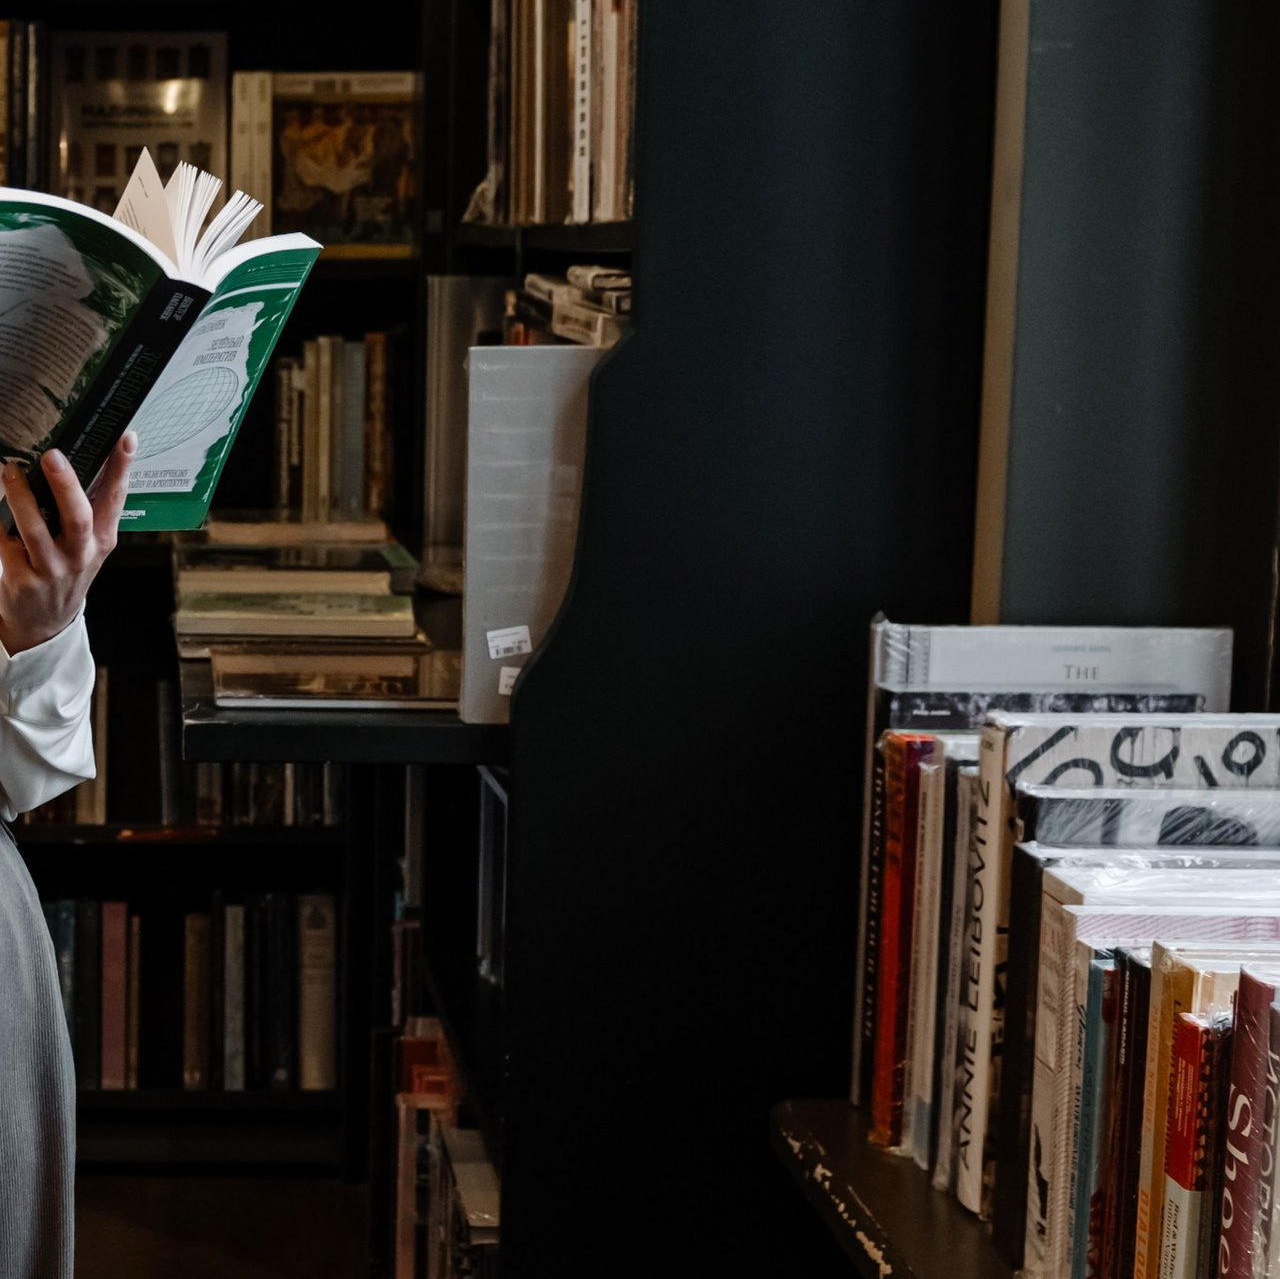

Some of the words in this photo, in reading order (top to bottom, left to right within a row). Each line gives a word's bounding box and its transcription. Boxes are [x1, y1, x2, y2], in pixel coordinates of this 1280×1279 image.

[1062, 664, 1099, 681] THE
[967, 778, 991, 1014] LEIBOVITZ
[958, 1028, 980, 1172] ANNIE
[1166, 1199, 1176, 1242] Infinite
[1170, 1203, 1181, 1229] Red
[1167, 1241, 1178, 1279] White
